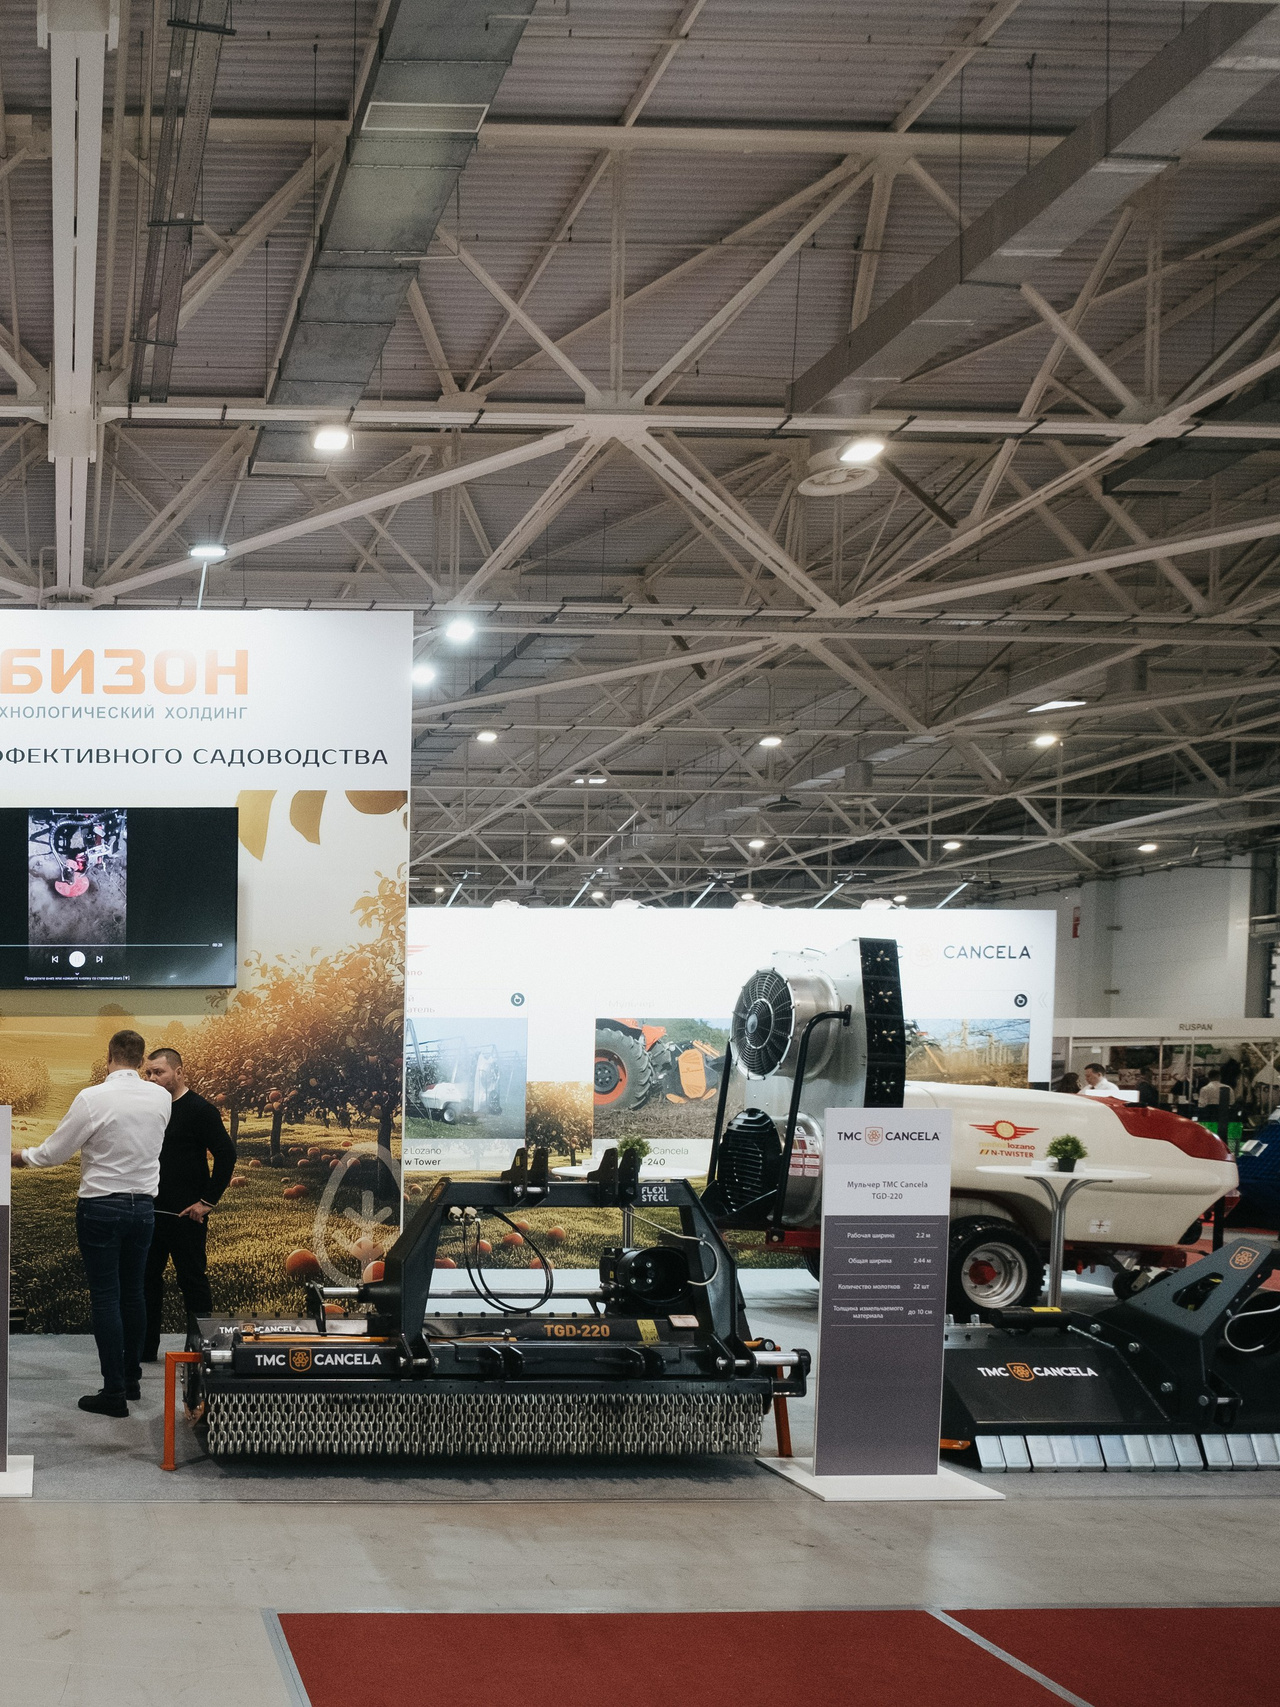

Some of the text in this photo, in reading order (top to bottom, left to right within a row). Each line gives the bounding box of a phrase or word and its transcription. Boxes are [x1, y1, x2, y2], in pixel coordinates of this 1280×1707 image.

[0, 648, 248, 695] БИЗОН
[165, 706, 248, 721] ХОЛДИНГ
[192, 749, 388, 768] САДОВОДСТВА
[944, 946, 1031, 959] CANCELA
[837, 1132, 940, 1141] TMC CANCELA
[652, 1147, 688, 1155] Cancela
[991, 1150, 1034, 1158] N-TWISTER
[414, 1158, 442, 1166] Tower
[847, 1181, 880, 1189] Мульчер
[642, 1194, 669, 1202] STEEL
[544, 1324, 610, 1337] TGD-220
[255, 1353, 382, 1366] TMC CANCELA
[977, 1367, 1098, 1376] TMC CANCELA
